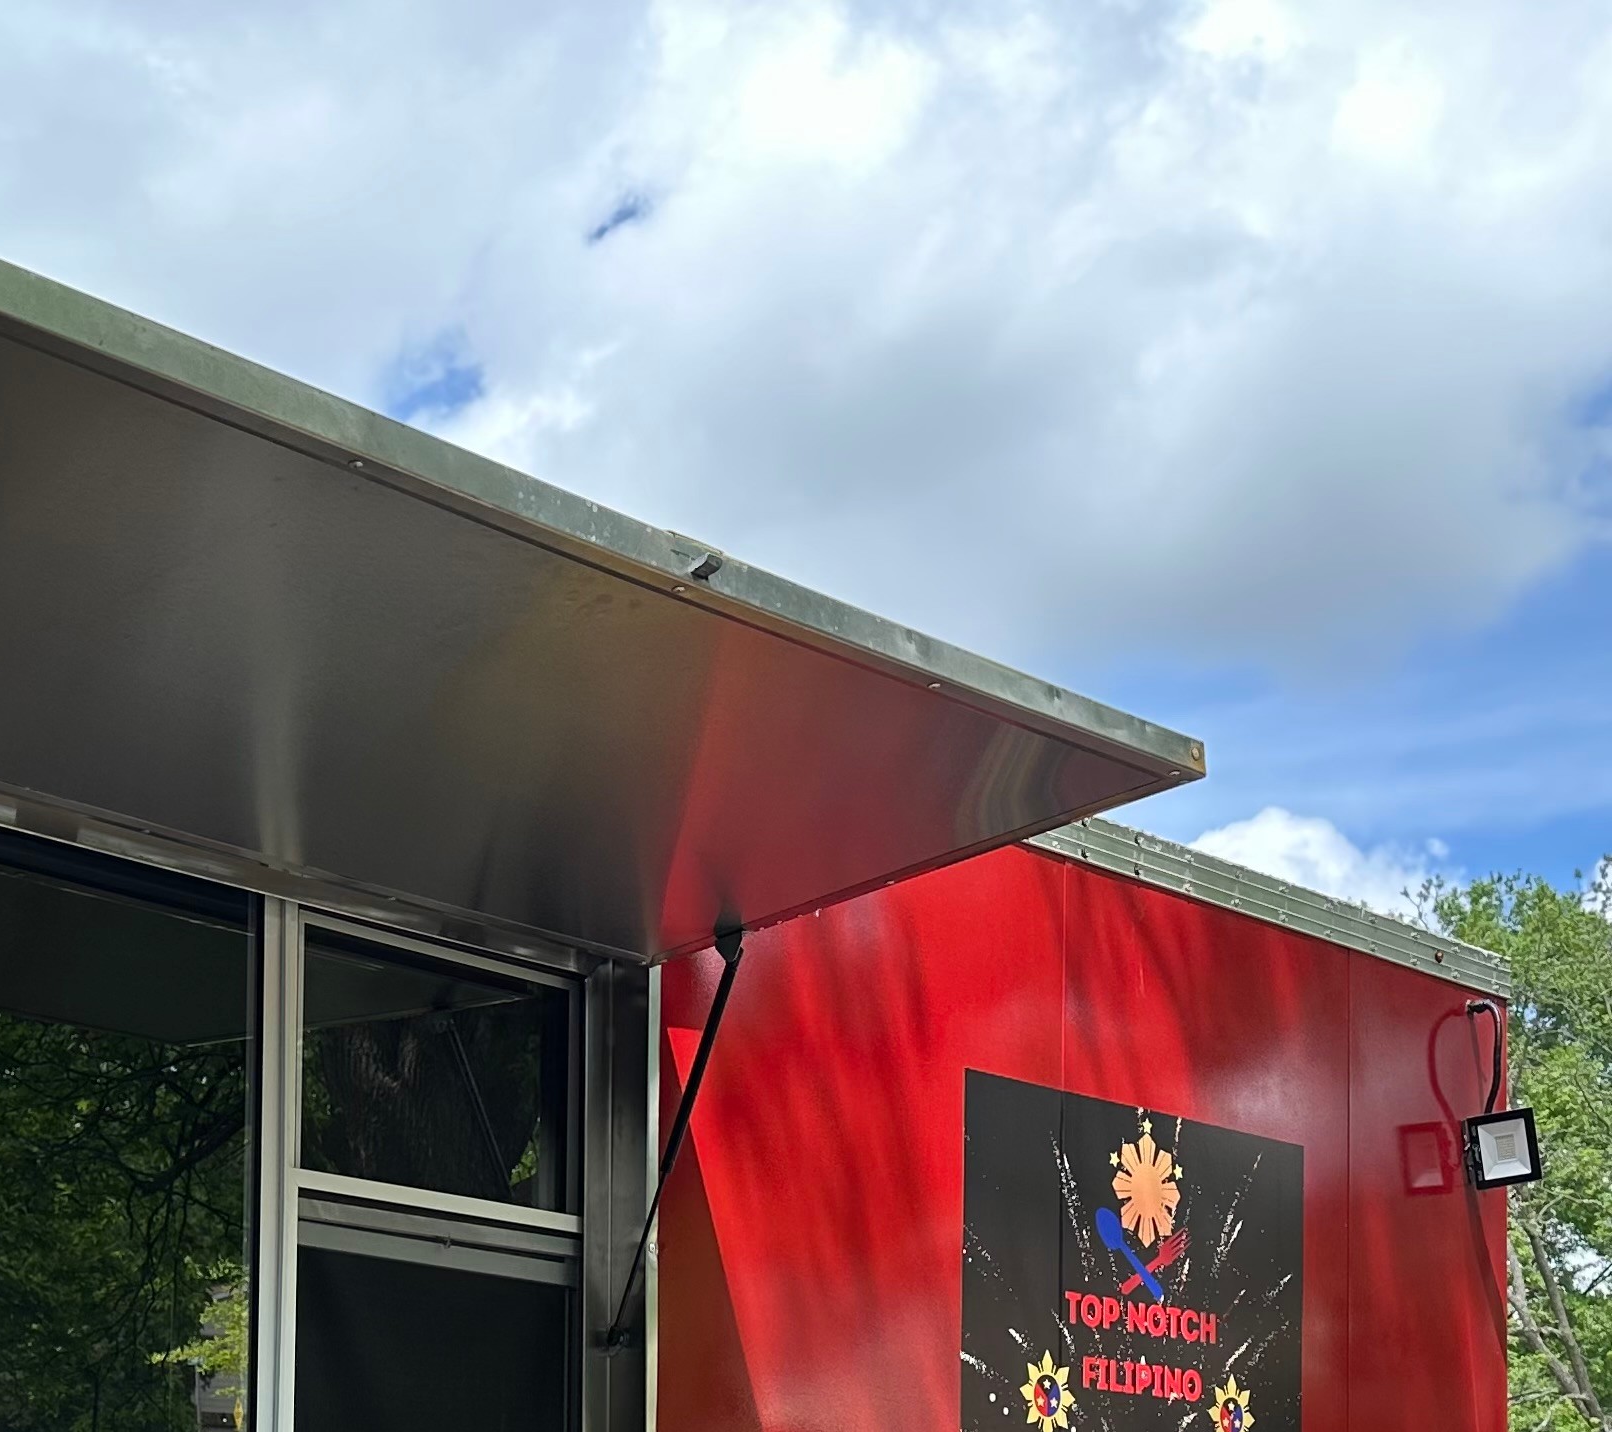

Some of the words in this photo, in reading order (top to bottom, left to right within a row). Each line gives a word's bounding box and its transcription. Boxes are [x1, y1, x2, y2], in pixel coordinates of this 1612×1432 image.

[1065, 1290, 1120, 1330] TOP
[1126, 1301, 1217, 1344] NOTCH
[1082, 1355, 1203, 1402] FILIPINO
